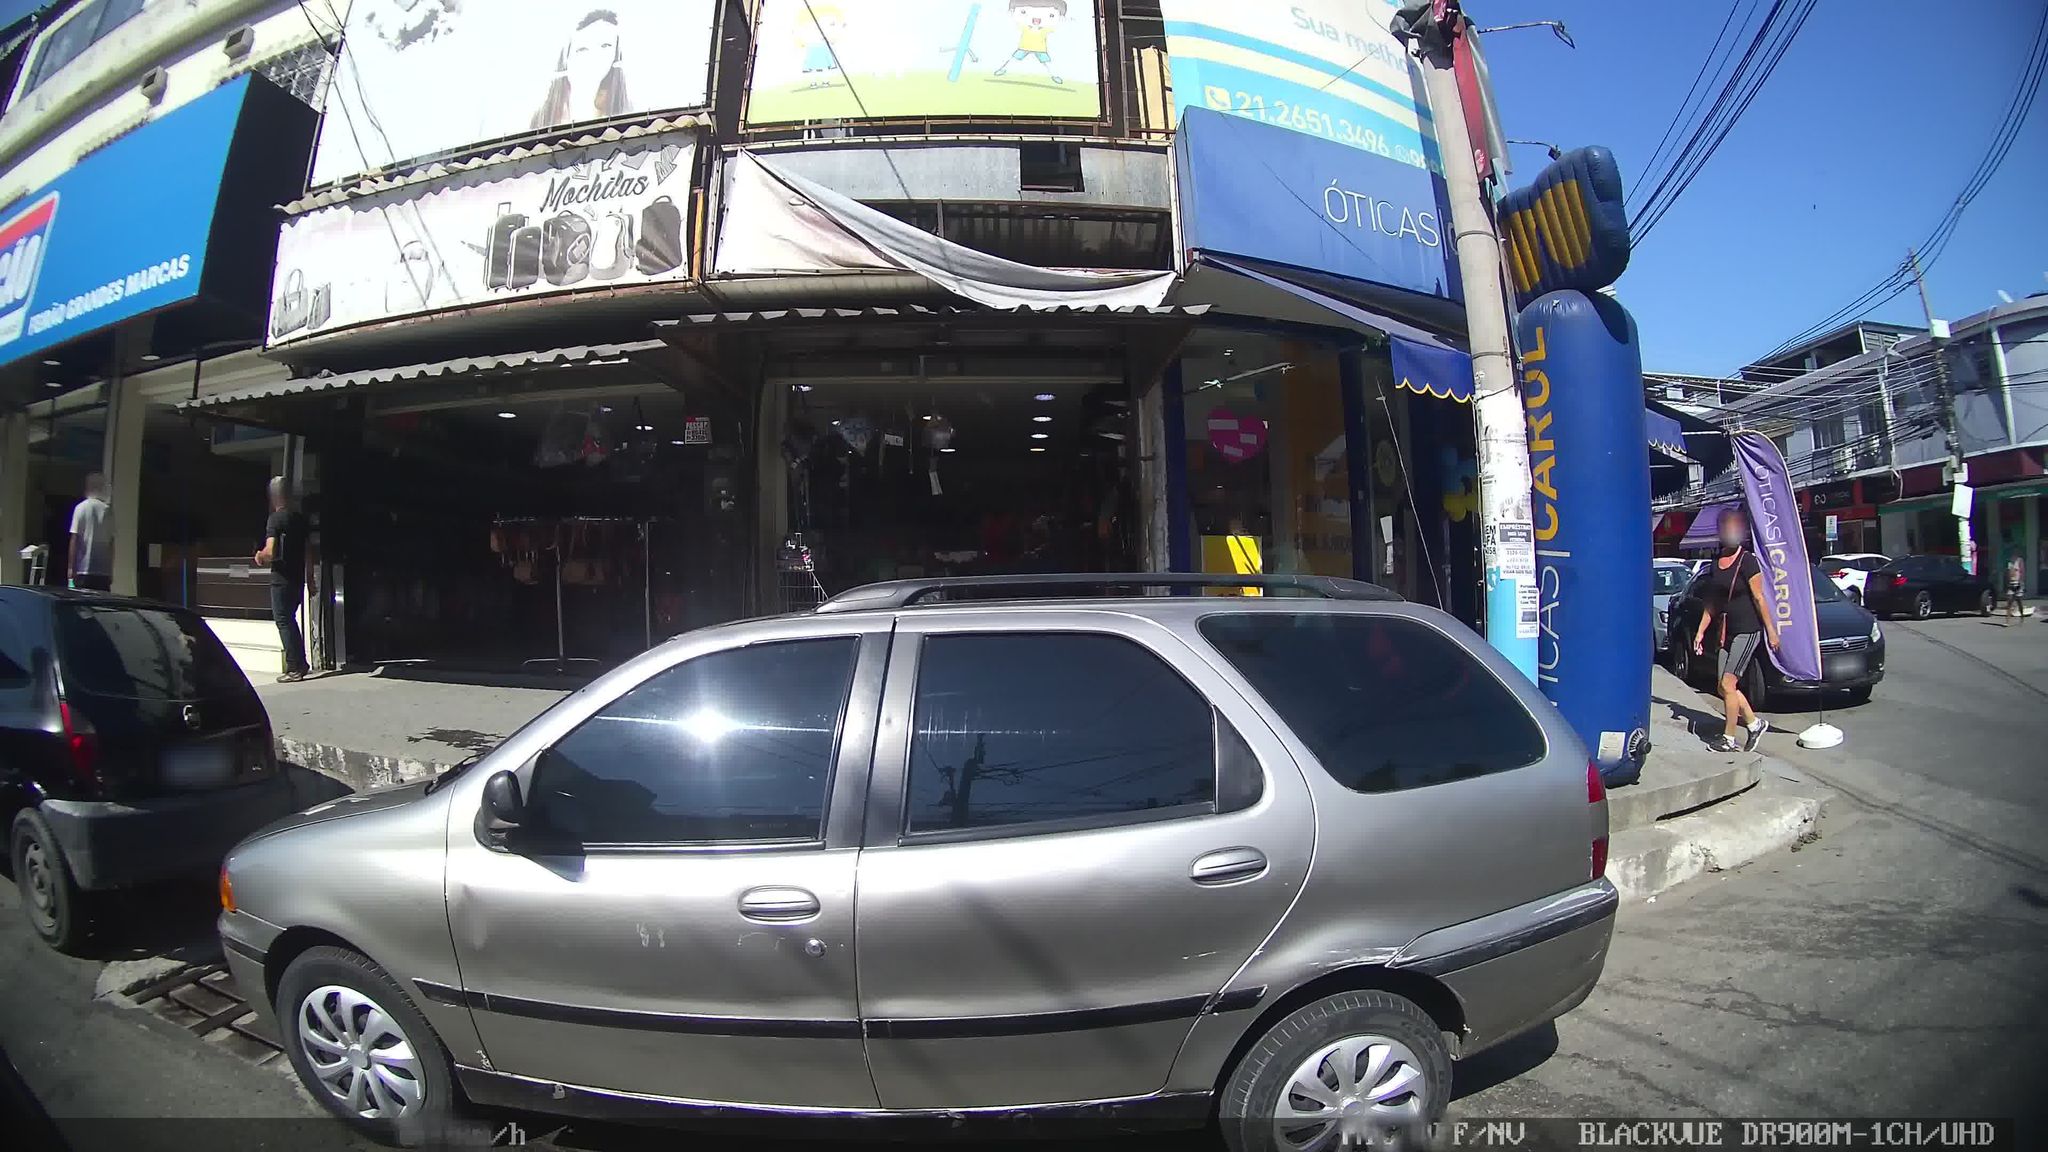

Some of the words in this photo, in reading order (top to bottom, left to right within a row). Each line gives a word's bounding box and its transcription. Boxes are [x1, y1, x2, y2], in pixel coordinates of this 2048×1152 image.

[1291, 6, 1340, 42] Sua
[1235, 90, 1391, 158] 21.2651.3496
[539, 170, 650, 213] Mochilas
[1324, 178, 1440, 247] ÓTICAS
[125, 254, 191, 297] MARCAS
[1769, 548, 1793, 635] CAROL
